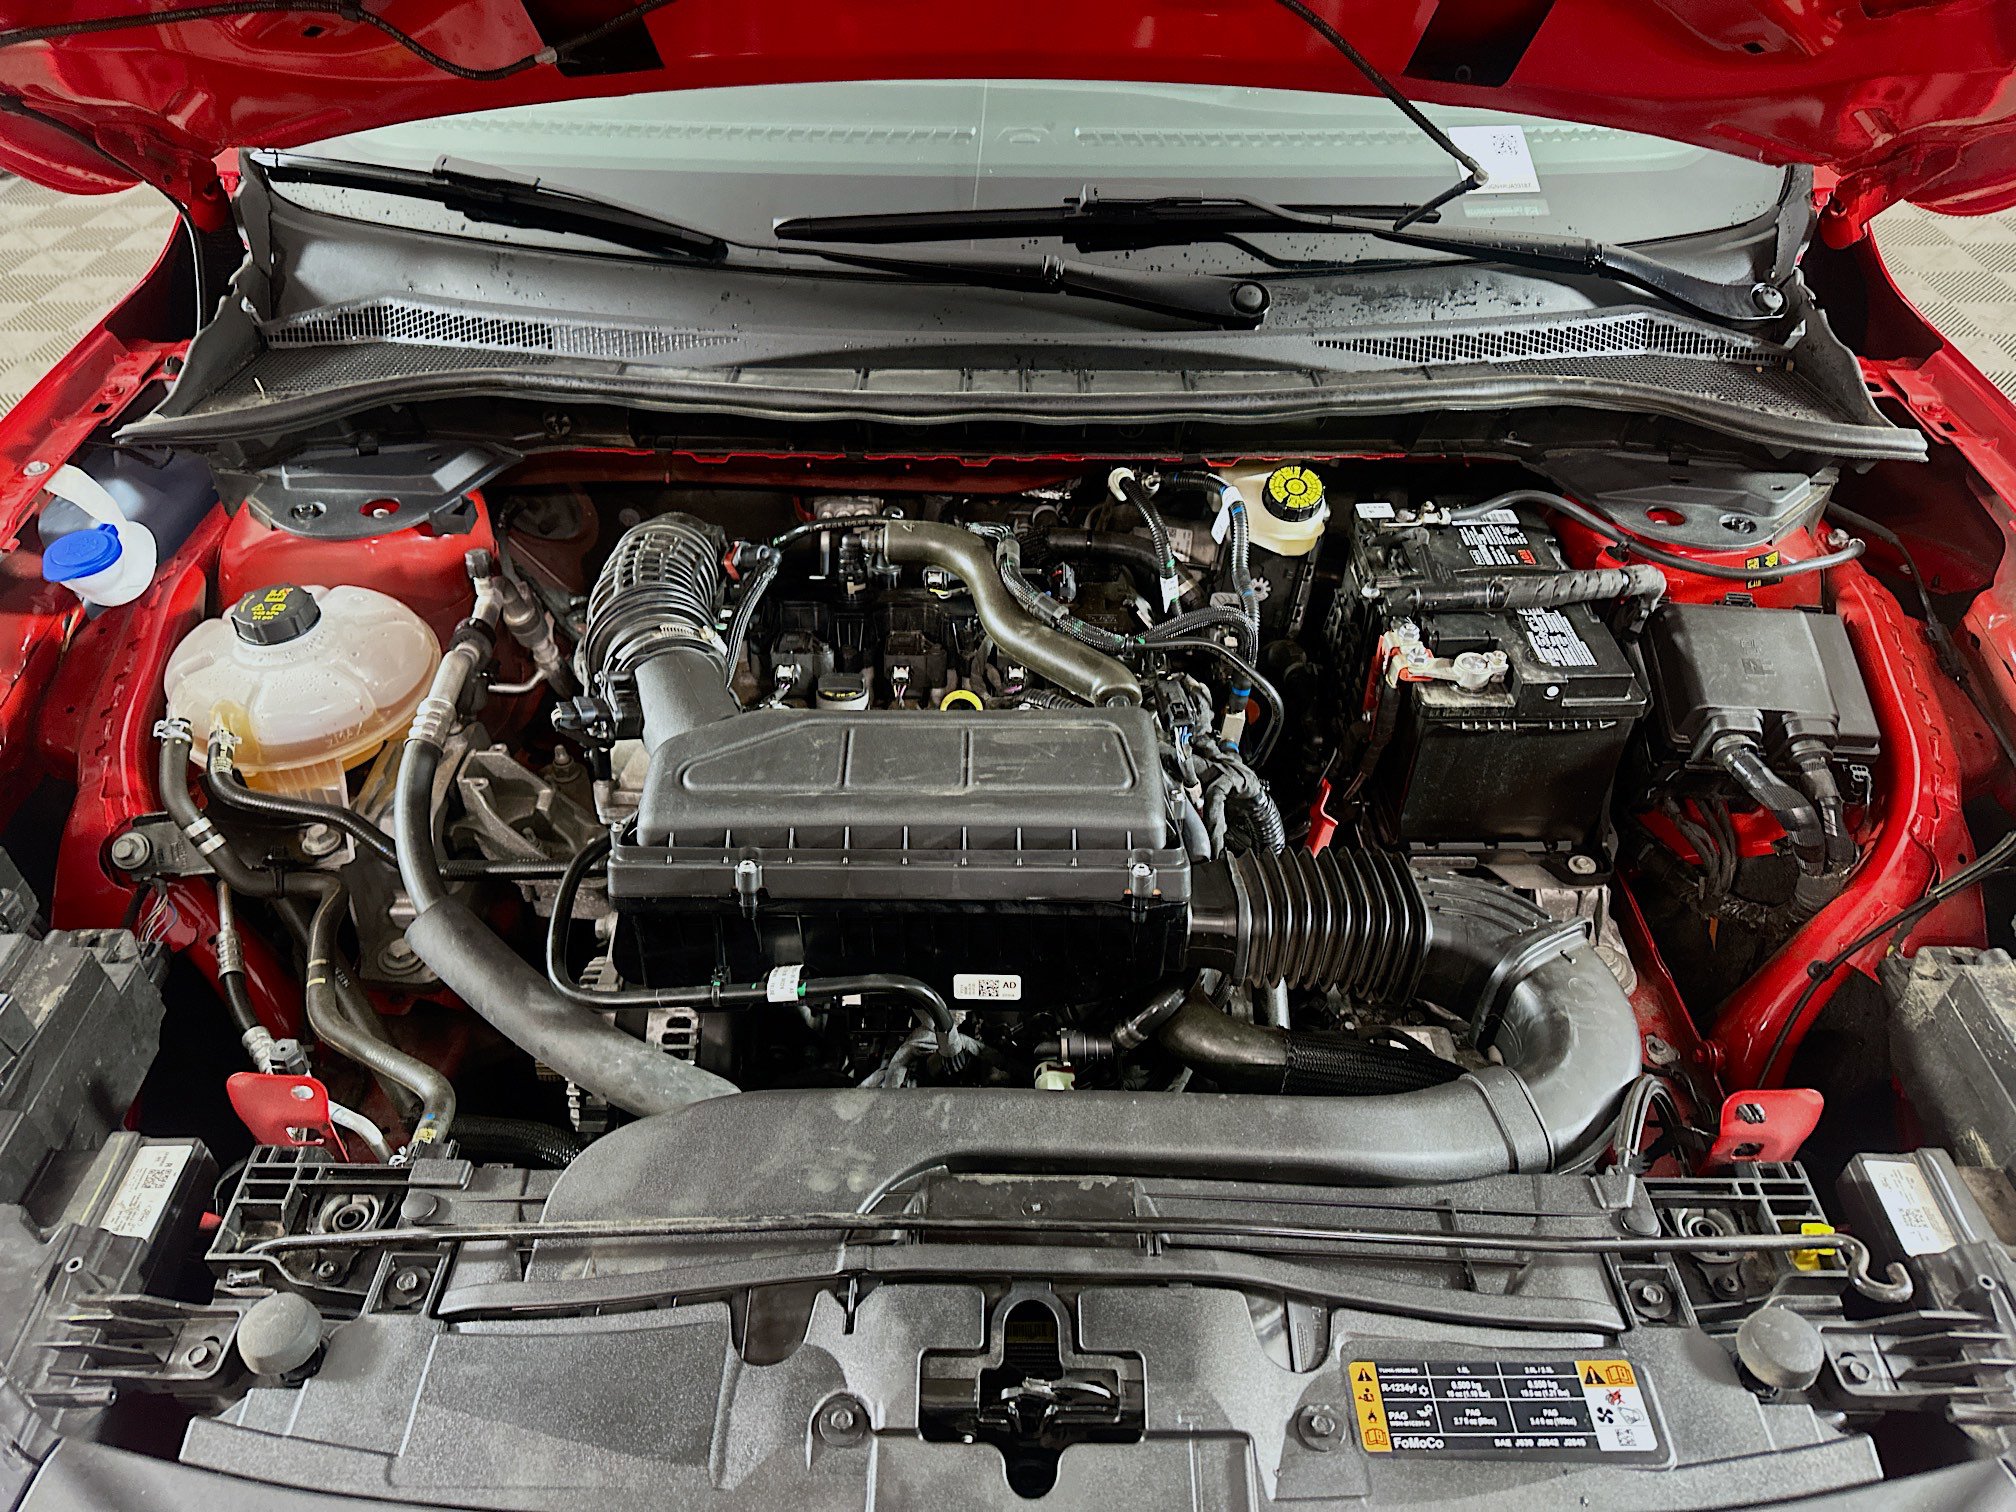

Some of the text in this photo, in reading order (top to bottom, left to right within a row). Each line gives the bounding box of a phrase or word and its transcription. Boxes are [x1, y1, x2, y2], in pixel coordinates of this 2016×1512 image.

[1002, 981, 1017, 989] AD
[1380, 1382, 1418, 1394] R-1234yf
[1388, 1411, 1409, 1420] PAG
[1464, 1408, 1481, 1417] PAG
[1542, 1408, 1559, 1417] PAG
[1392, 1436, 1445, 1449] FoMoCo
